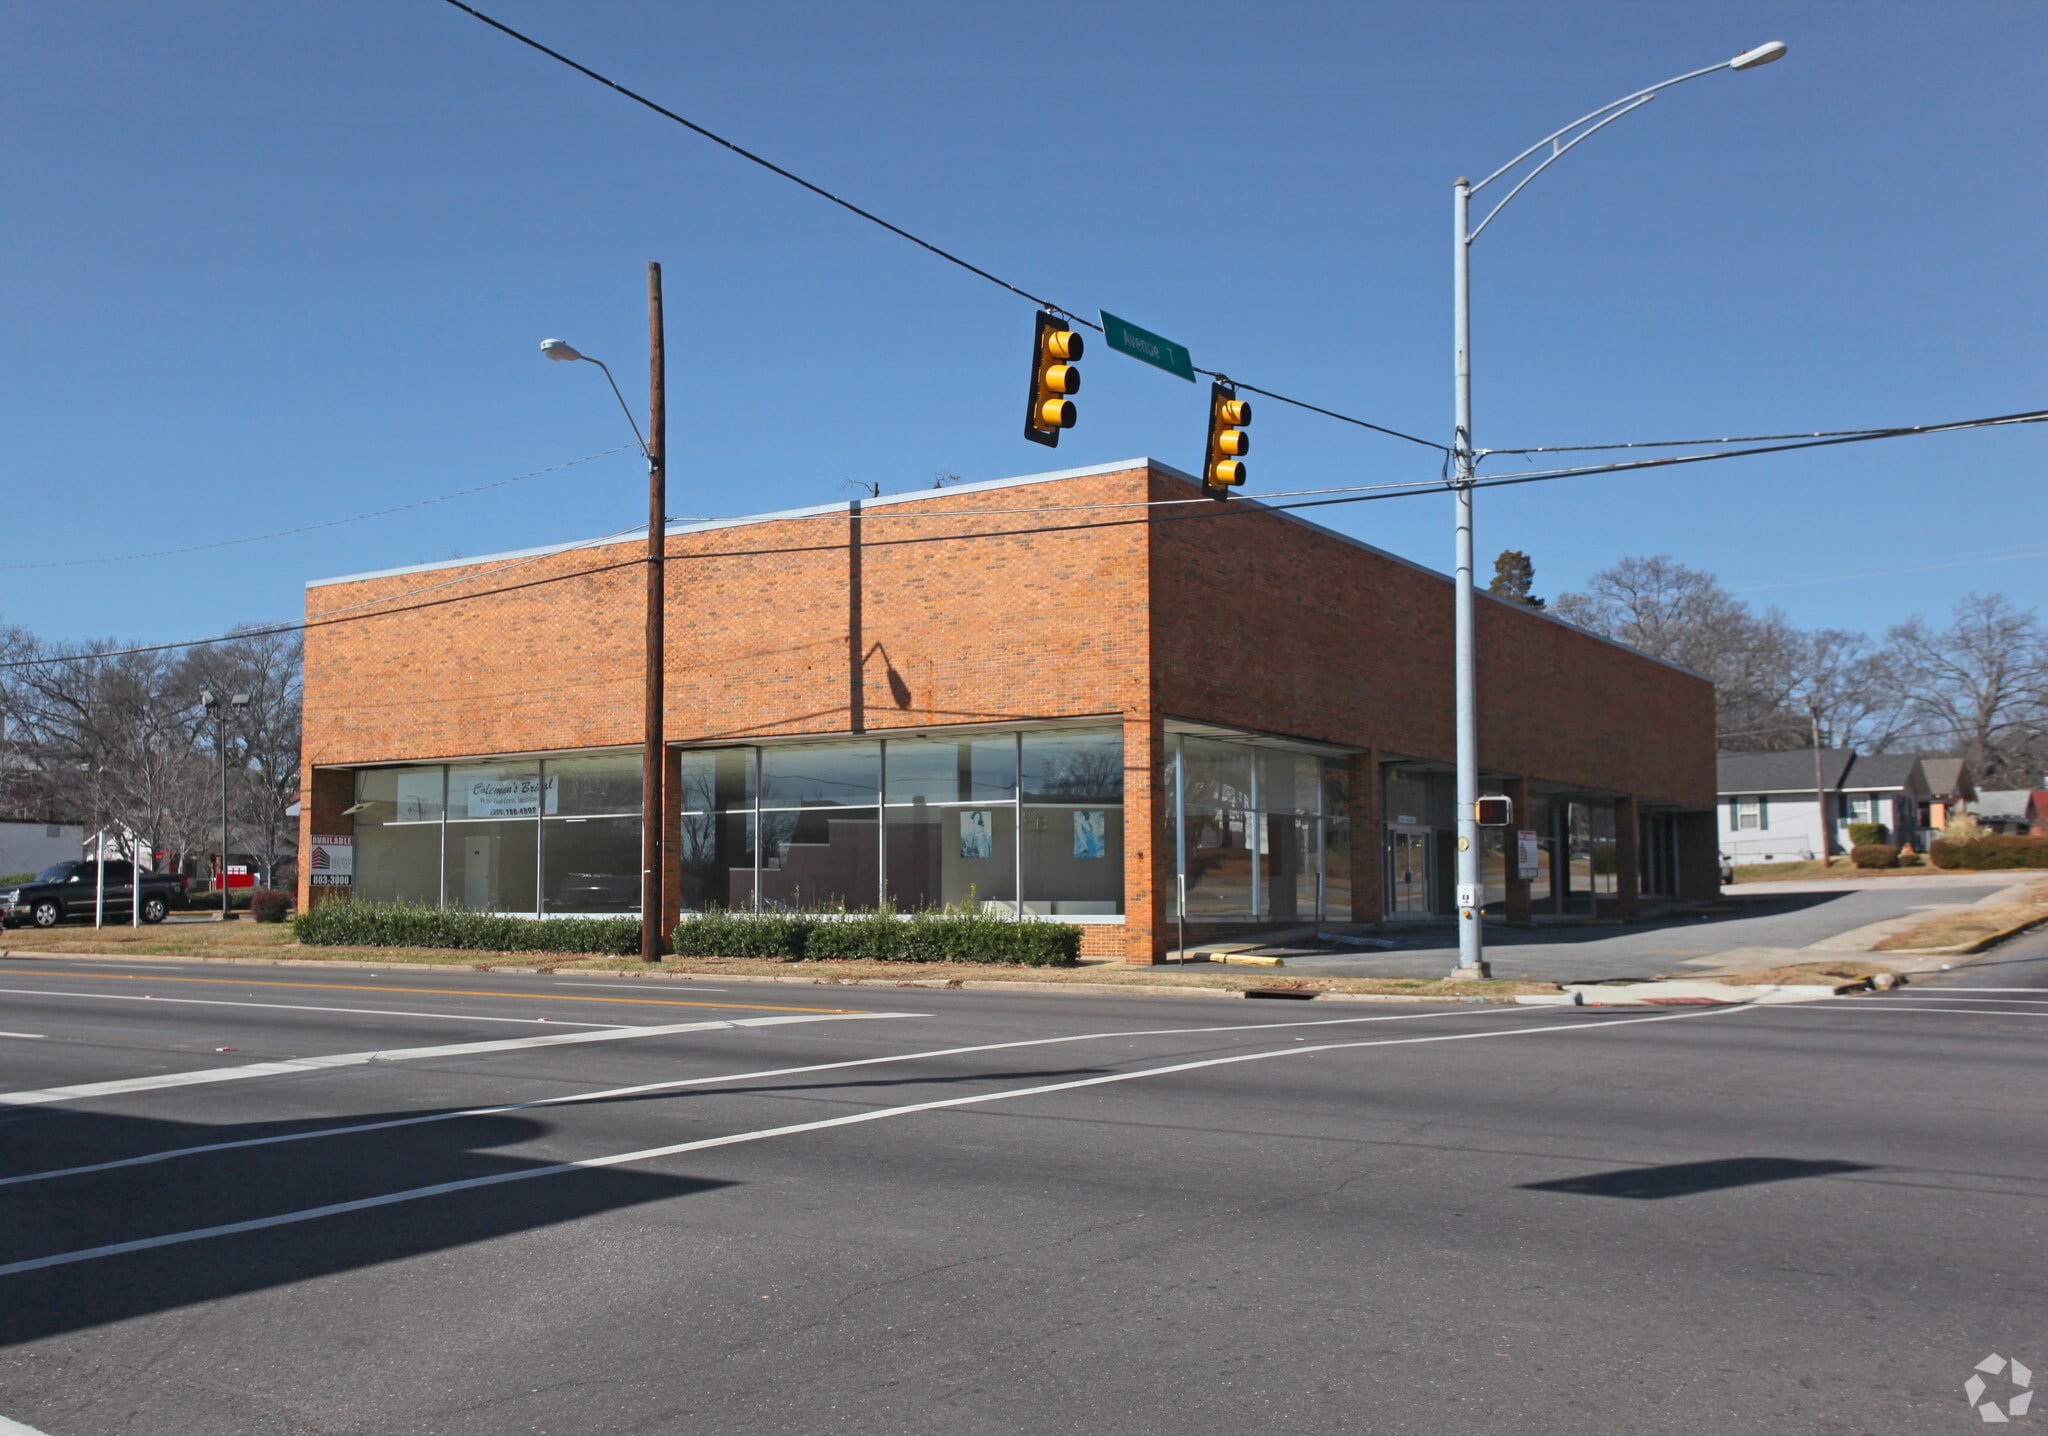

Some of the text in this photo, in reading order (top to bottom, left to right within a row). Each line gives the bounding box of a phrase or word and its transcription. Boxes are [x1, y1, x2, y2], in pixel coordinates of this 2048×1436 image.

[1123, 328, 1161, 360] Avenue
[473, 778, 553, 796] Coleman's Brial
[312, 836, 352, 845] AVAILABLE
[313, 875, 349, 885] 803-3000
